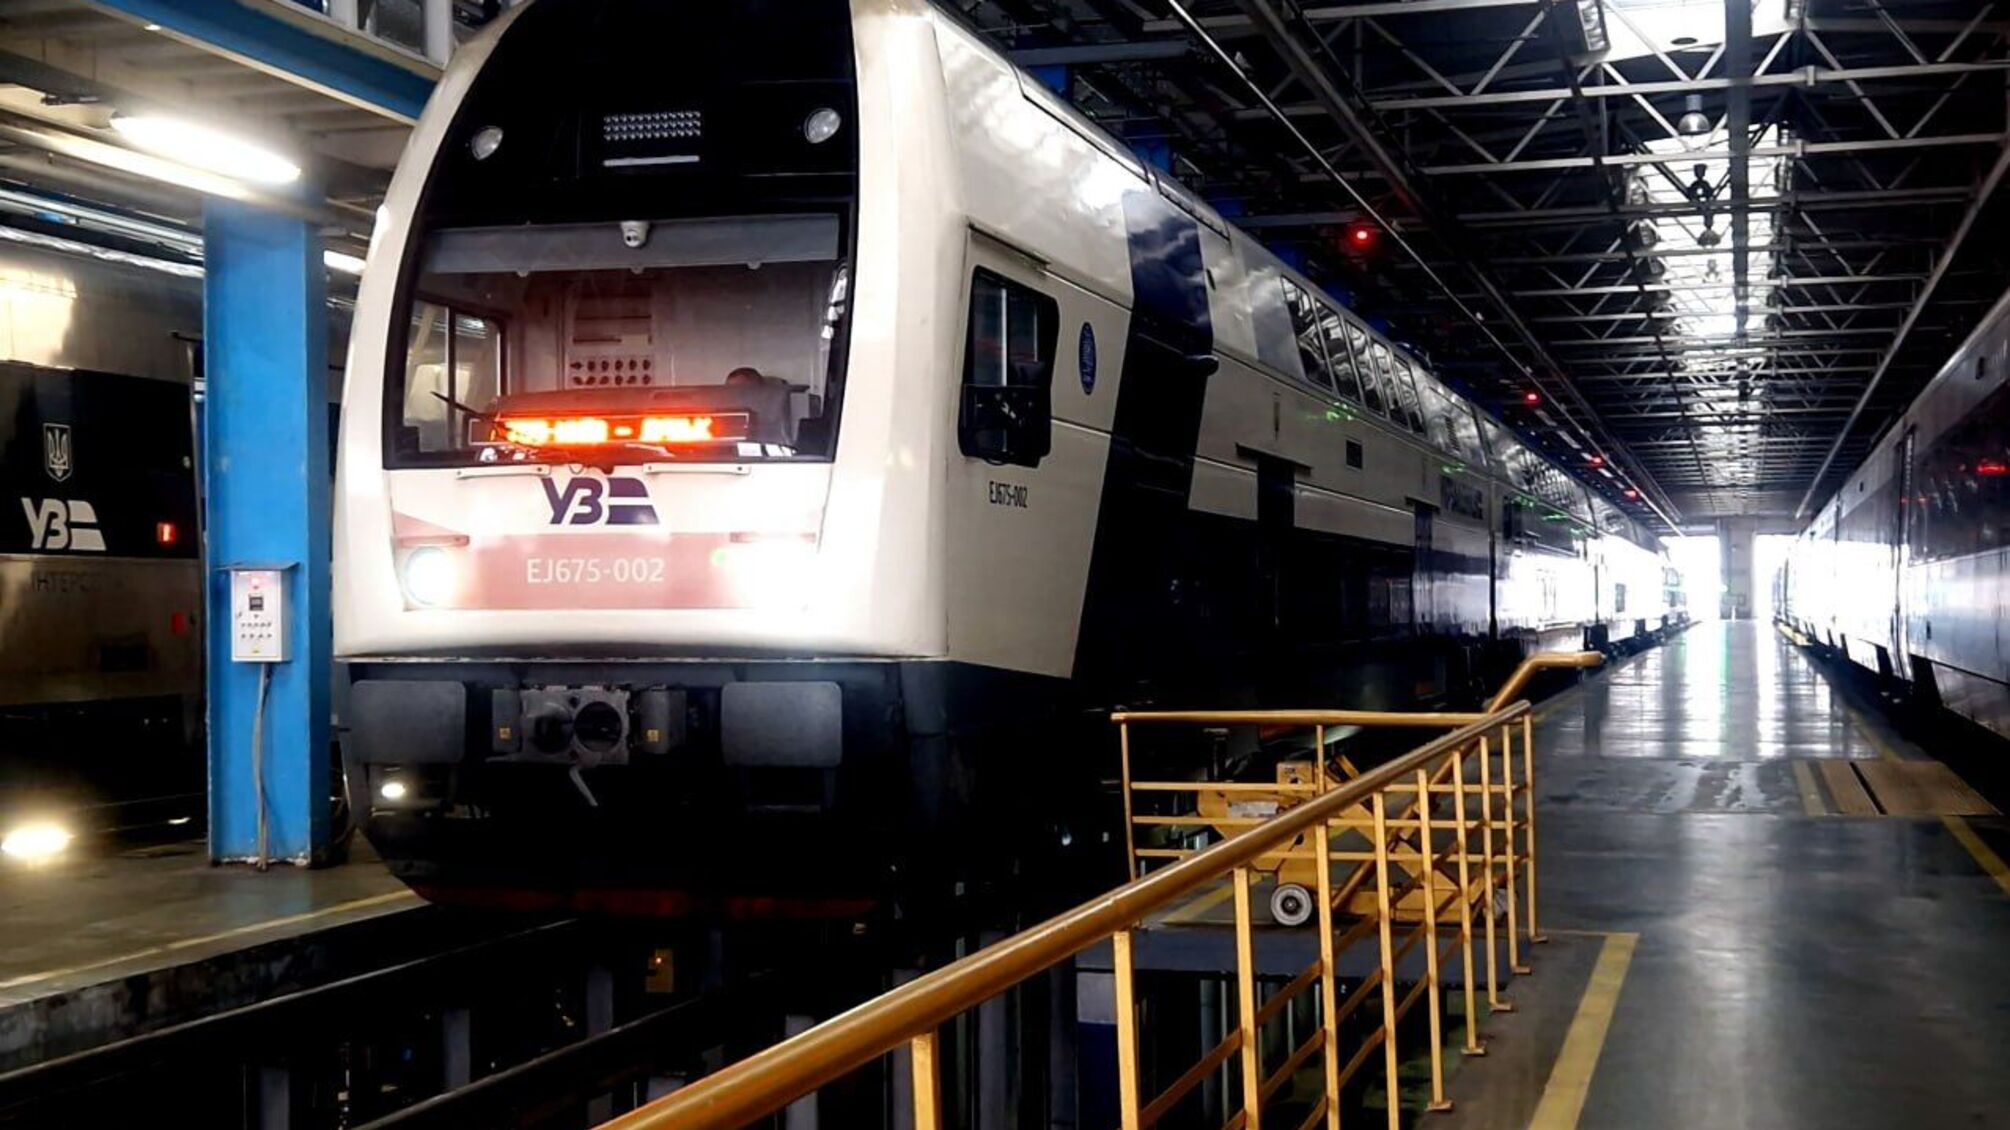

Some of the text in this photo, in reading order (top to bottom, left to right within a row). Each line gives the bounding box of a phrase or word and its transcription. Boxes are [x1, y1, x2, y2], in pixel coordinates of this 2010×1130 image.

[21, 497, 68, 550] УЗ
[541, 477, 603, 525] УЗ
[527, 558, 665, 584] EJ675-002
